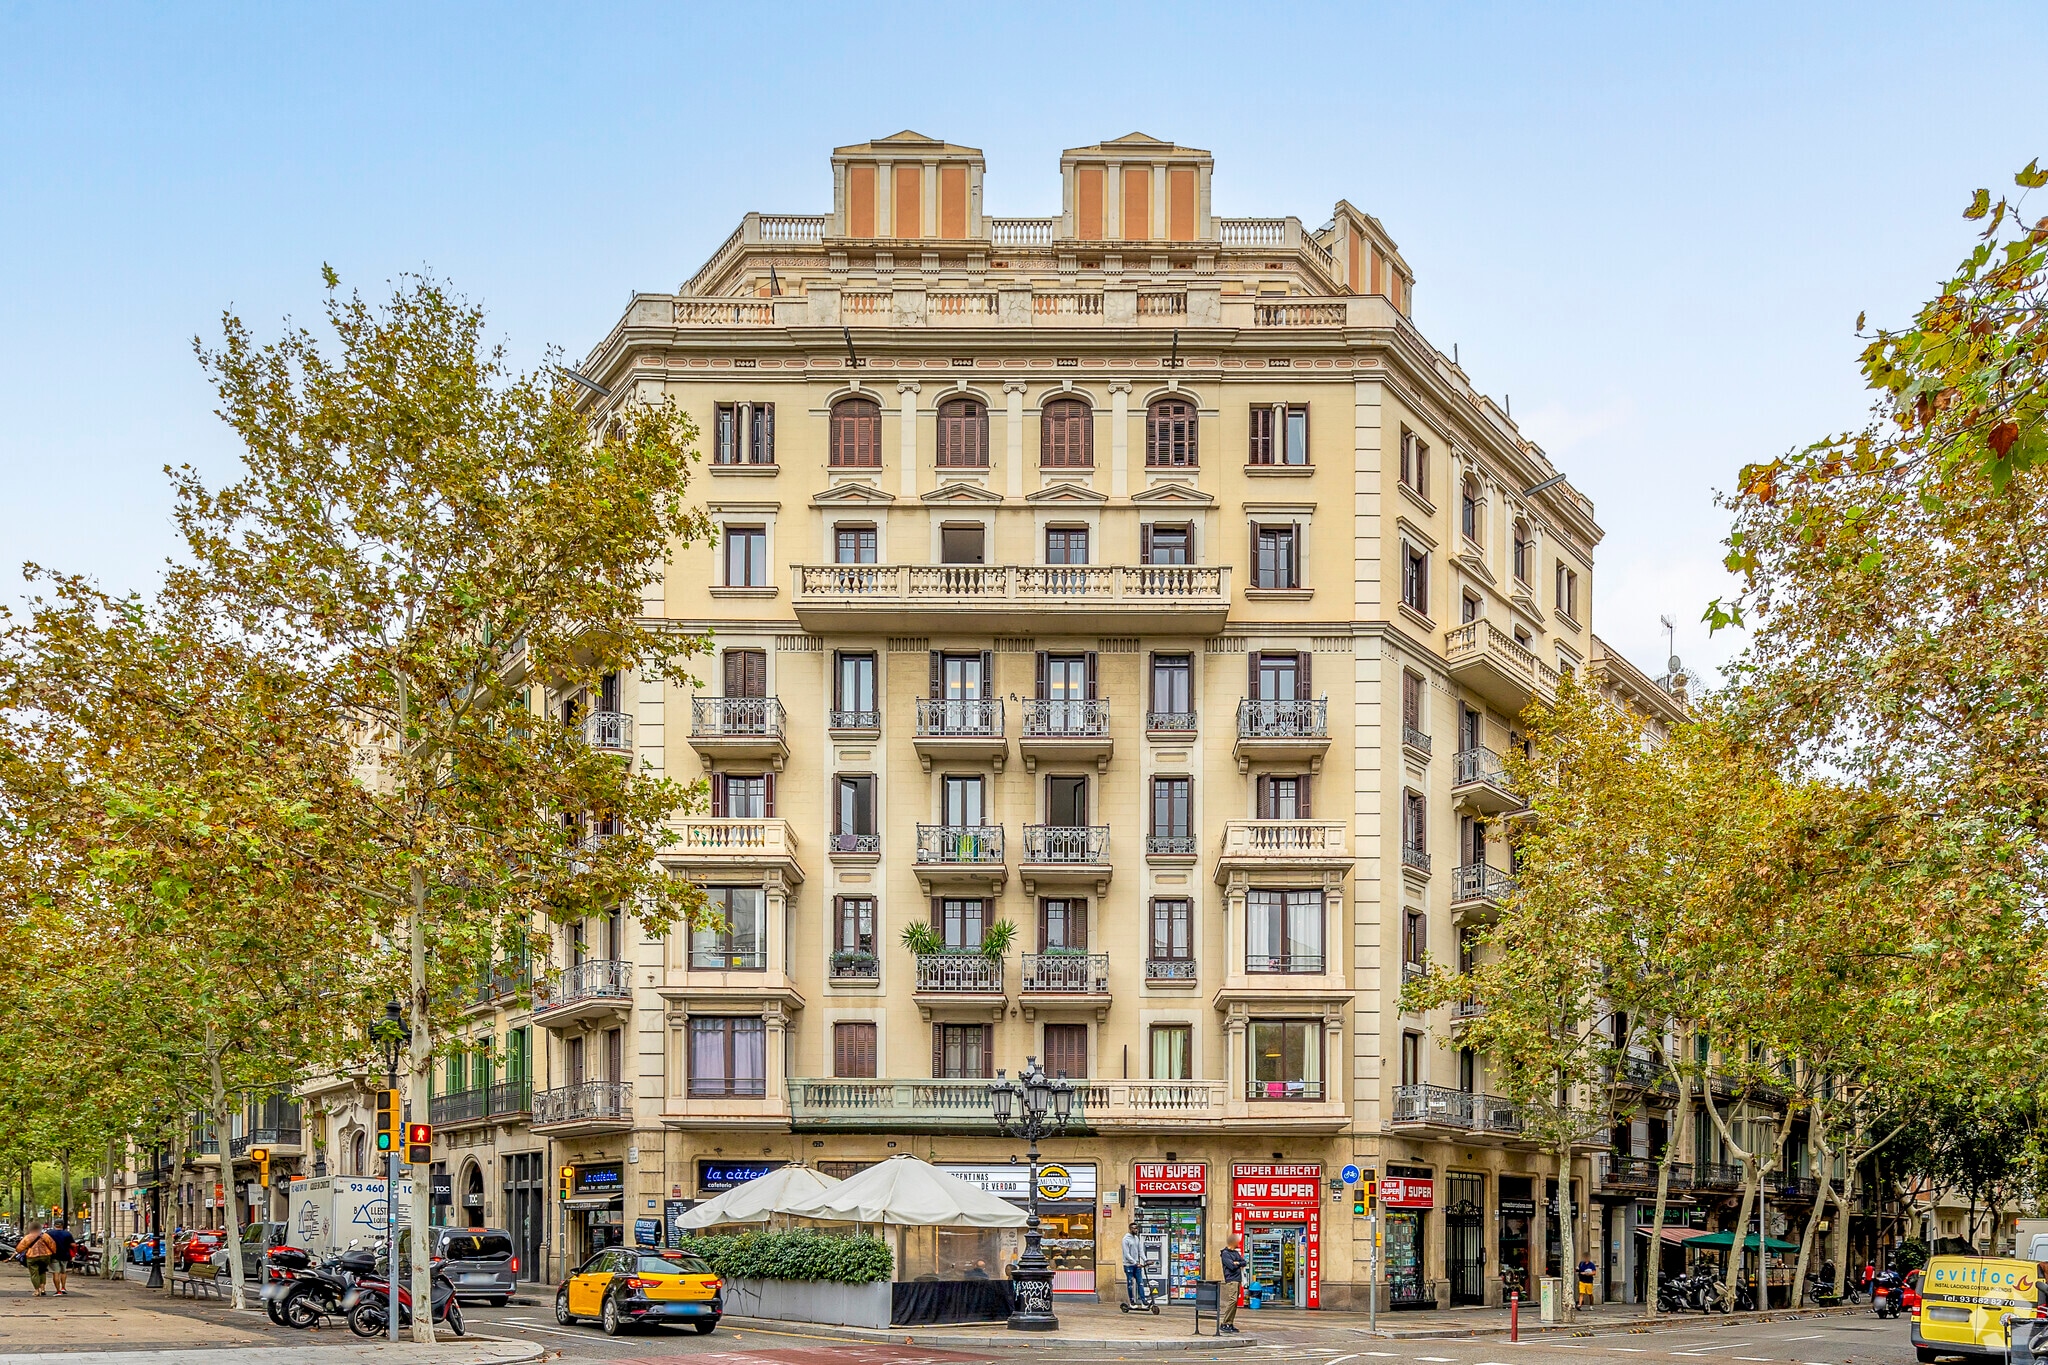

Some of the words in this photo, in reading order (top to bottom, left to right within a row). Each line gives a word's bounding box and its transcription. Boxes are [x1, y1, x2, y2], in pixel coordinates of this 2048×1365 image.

[707, 1167, 721, 1179] la
[726, 1168, 769, 1180] càted
[1140, 1166, 1164, 1178] NEW
[1166, 1166, 1201, 1178] SUPER
[1236, 1166, 1271, 1175] SUPER
[1275, 1167, 1318, 1175] MERCAT
[350, 1183, 363, 1192] 93
[365, 1184, 385, 1193] 460
[981, 1182, 989, 1190] DE
[1140, 1183, 1187, 1191] MERCATS
[1237, 1184, 1268, 1197] NEW
[1271, 1184, 1314, 1197] SUPER
[1408, 1186, 1432, 1198] SUPER
[1310, 1213, 1318, 1243] NEW
[1310, 1249, 1318, 1299] SUPER
[1935, 1267, 2015, 1285] evitfoc
[1942, 1294, 1958, 1302] Tel.
[1972, 1297, 1989, 1305] 682
[1990, 1298, 2002, 1306] 82
[2004, 1299, 2015, 1307] 70
